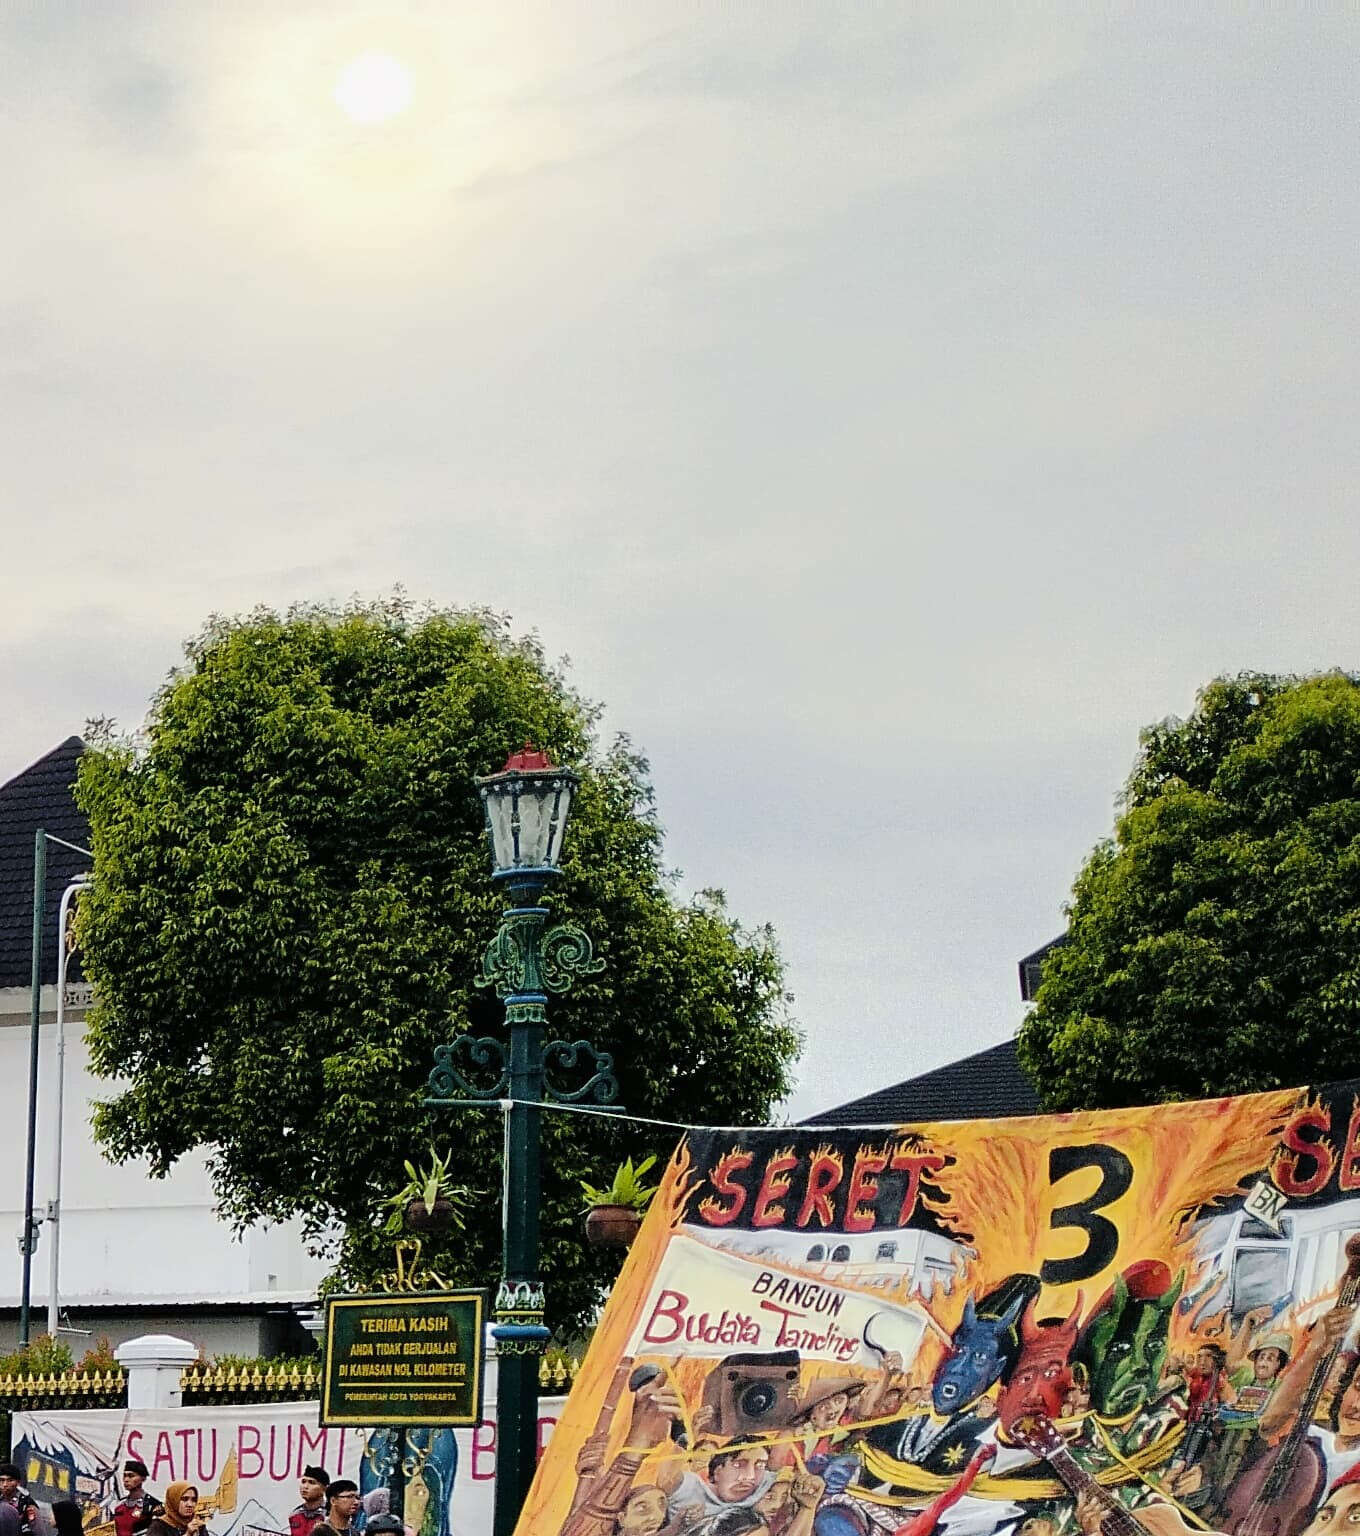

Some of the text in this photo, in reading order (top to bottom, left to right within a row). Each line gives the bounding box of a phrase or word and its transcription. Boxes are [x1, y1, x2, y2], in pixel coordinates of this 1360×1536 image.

[698, 1145, 947, 1232] SERET
[1040, 1143, 1137, 1285] 3
[752, 1272, 845, 1317] BANGUN
[361, 1317, 448, 1332] TERIMA KASIH
[760, 1300, 860, 1361] Tanding
[339, 1363, 466, 1376] DI KAWASAN NOL KILOMETER
[350, 1342, 457, 1356] ANDA TIDAK BERJUALAN
[409, 1391, 457, 1401] YOGYAKARTA
[127, 1427, 217, 1481] SATU
[237, 1424, 345, 1481] BUMI
